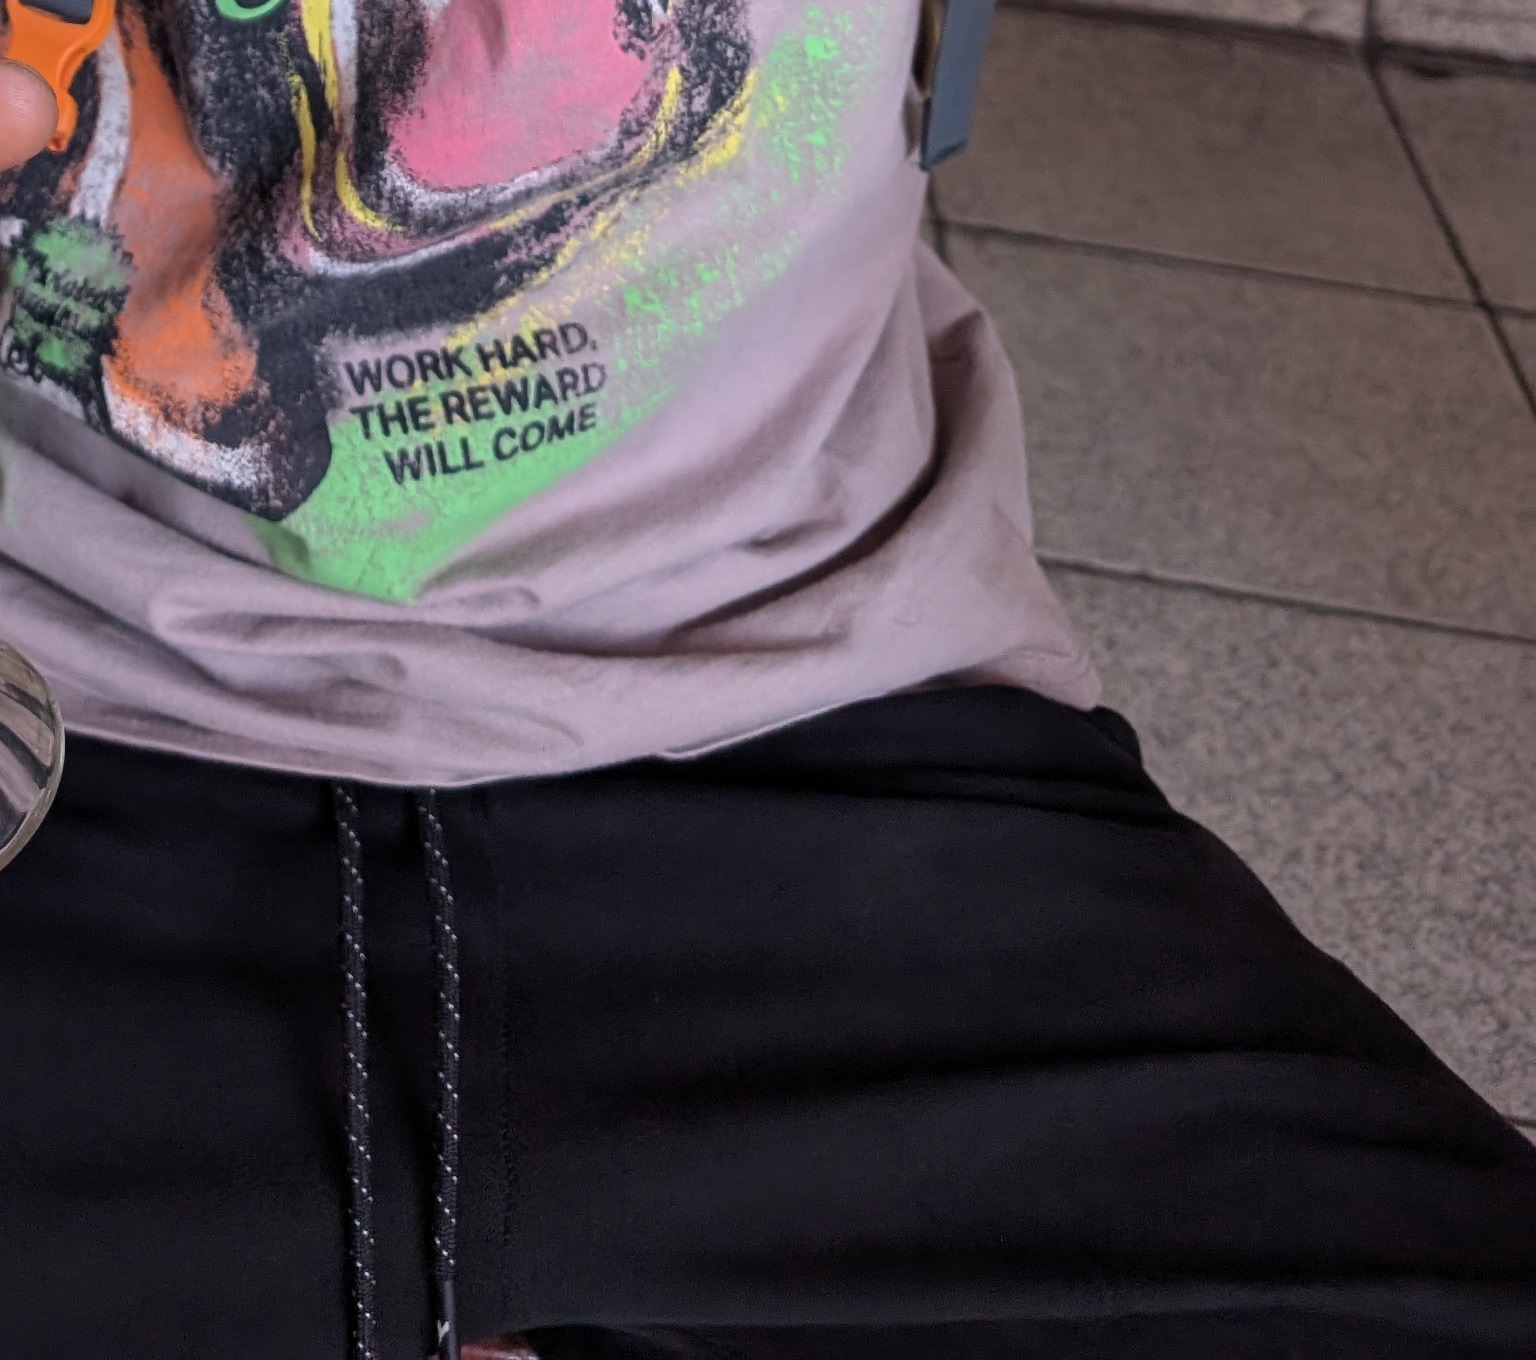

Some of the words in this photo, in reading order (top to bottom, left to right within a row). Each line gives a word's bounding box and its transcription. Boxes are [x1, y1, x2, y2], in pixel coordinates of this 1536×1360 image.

[343, 348, 474, 397] WORK
[475, 321, 598, 373] HARD.
[349, 394, 436, 441] THE
[439, 361, 607, 427] REWARD
[382, 435, 485, 486] WILL
[492, 400, 599, 462] COME
